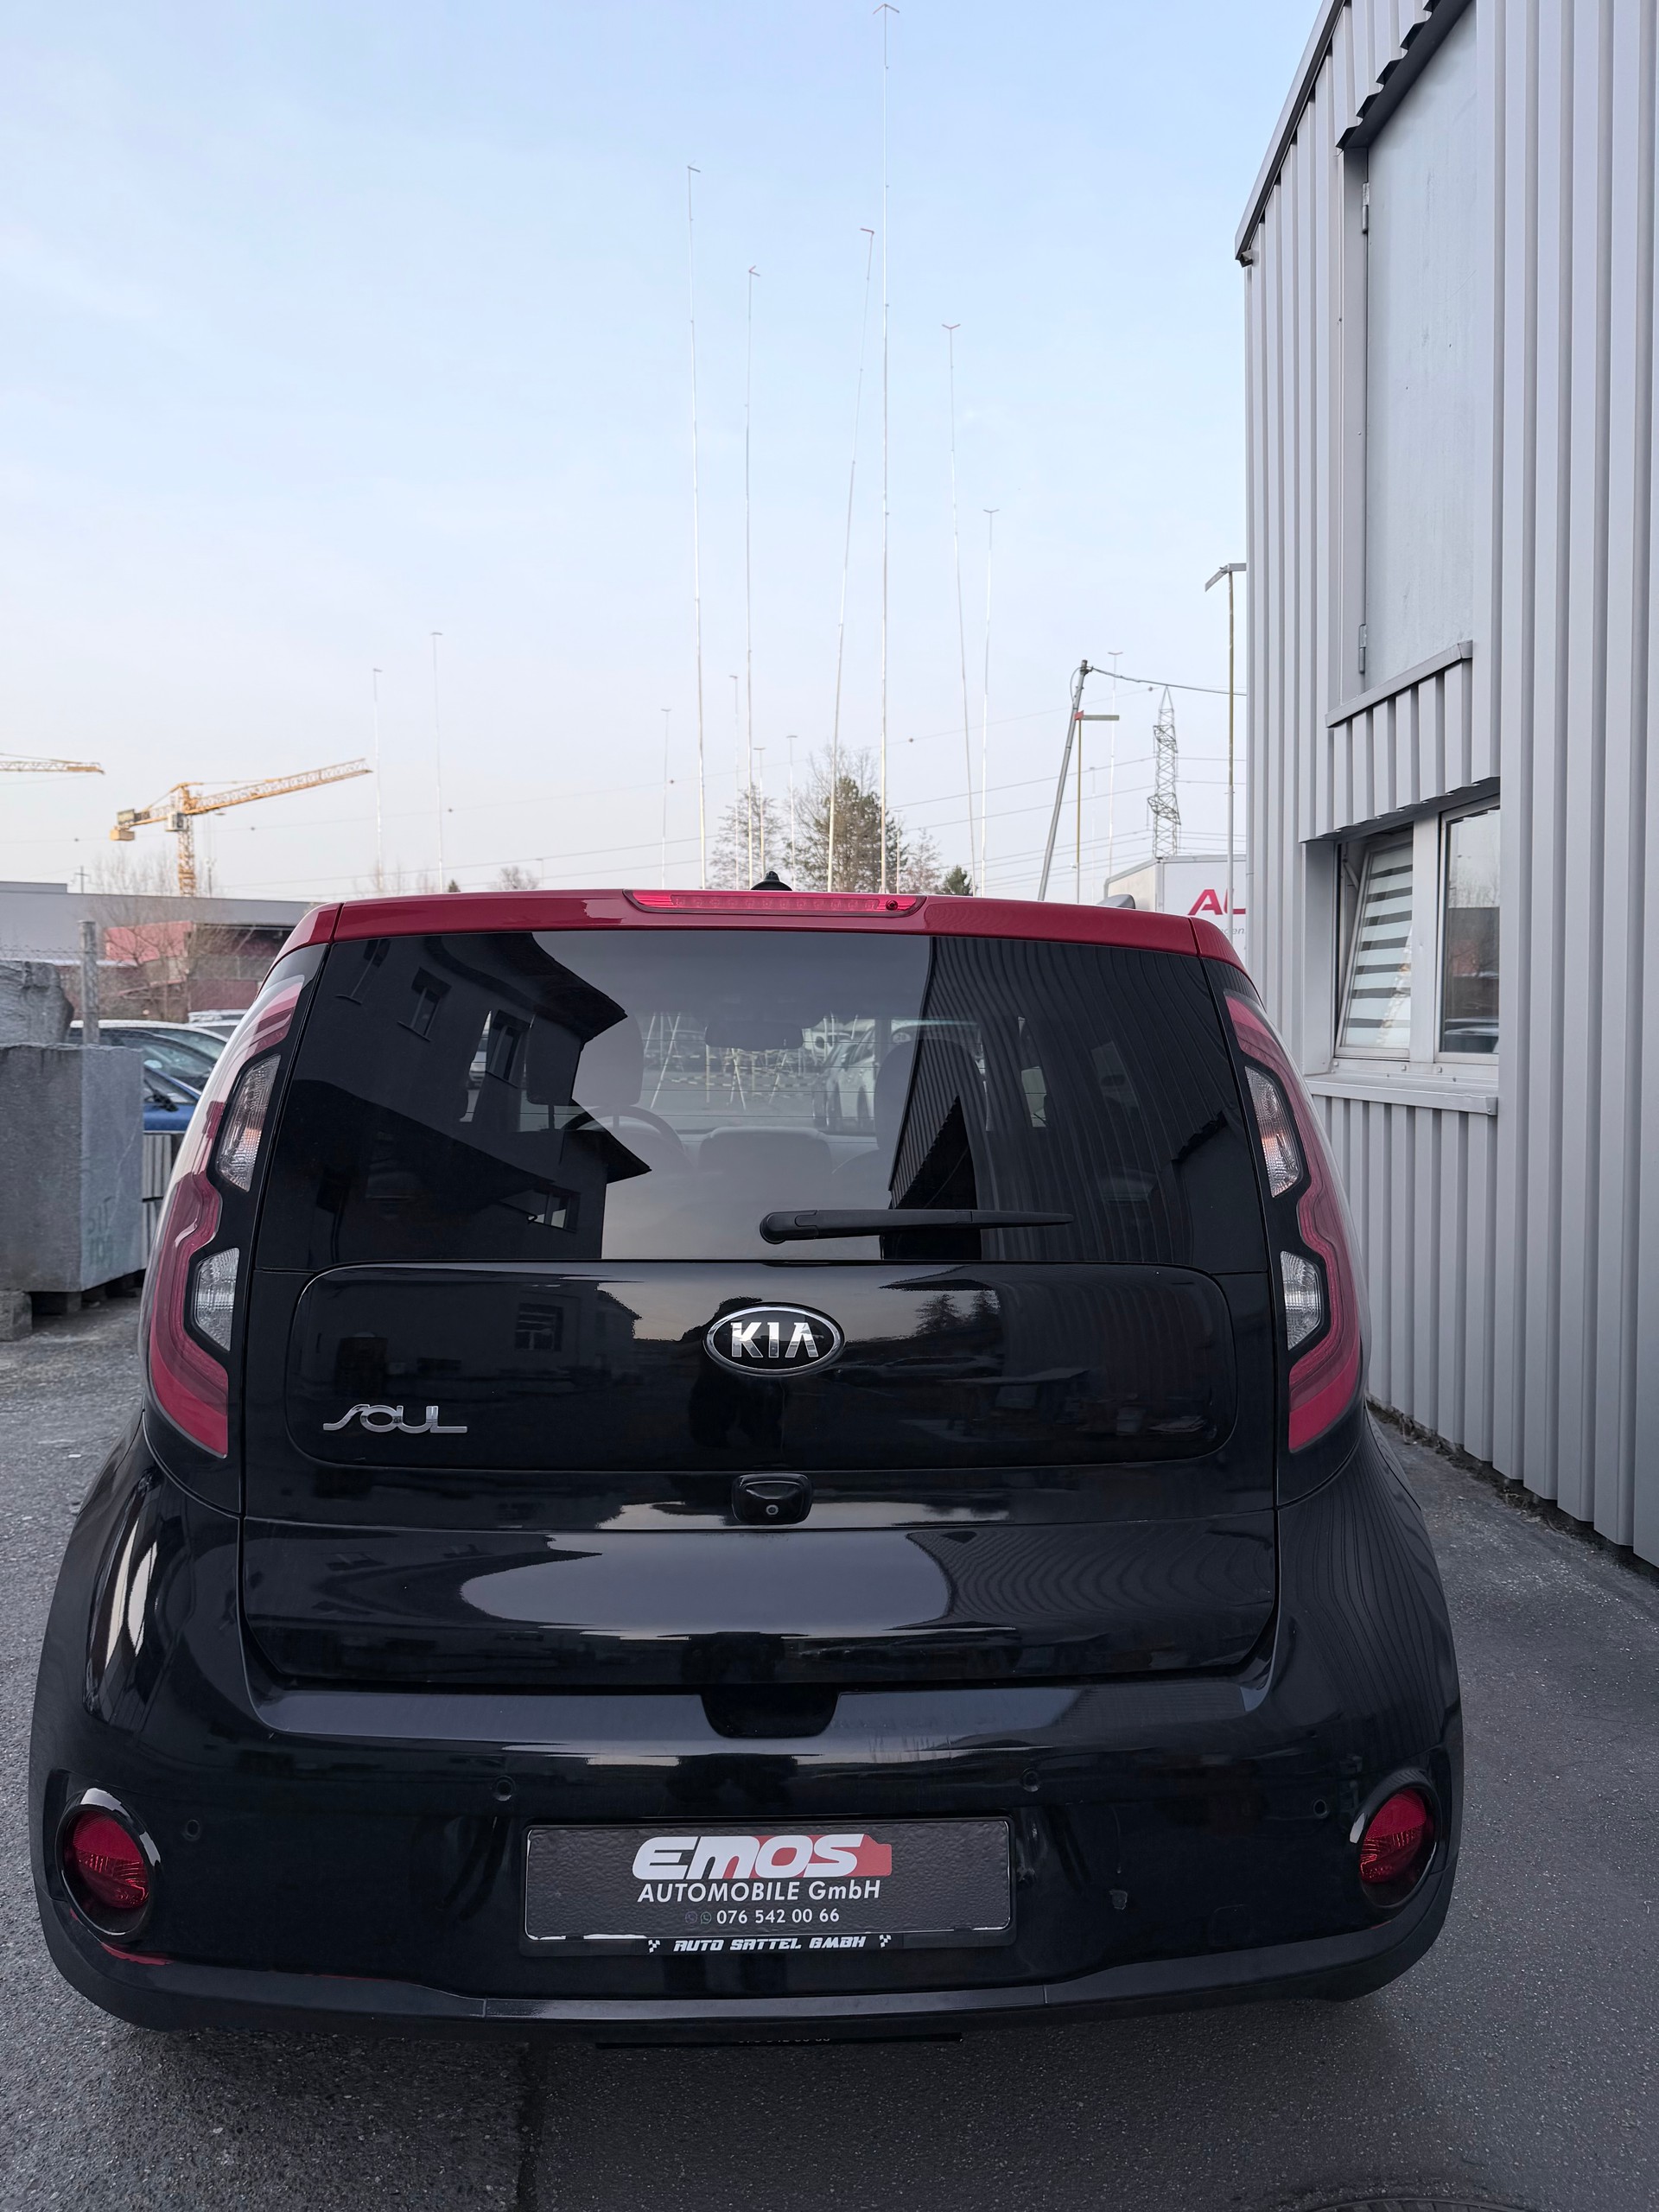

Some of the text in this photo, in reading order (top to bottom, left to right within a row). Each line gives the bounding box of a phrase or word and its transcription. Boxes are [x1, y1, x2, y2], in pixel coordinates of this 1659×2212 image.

[730, 1322, 819, 1358] KIA
[322, 1403, 468, 1434] SOUL
[637, 1879, 880, 1903] AUTOMOBILE GmbH
[716, 1907, 840, 1925] 076 542 00 66
[673, 1936, 866, 1952] AUTO SATTEL GMBH
